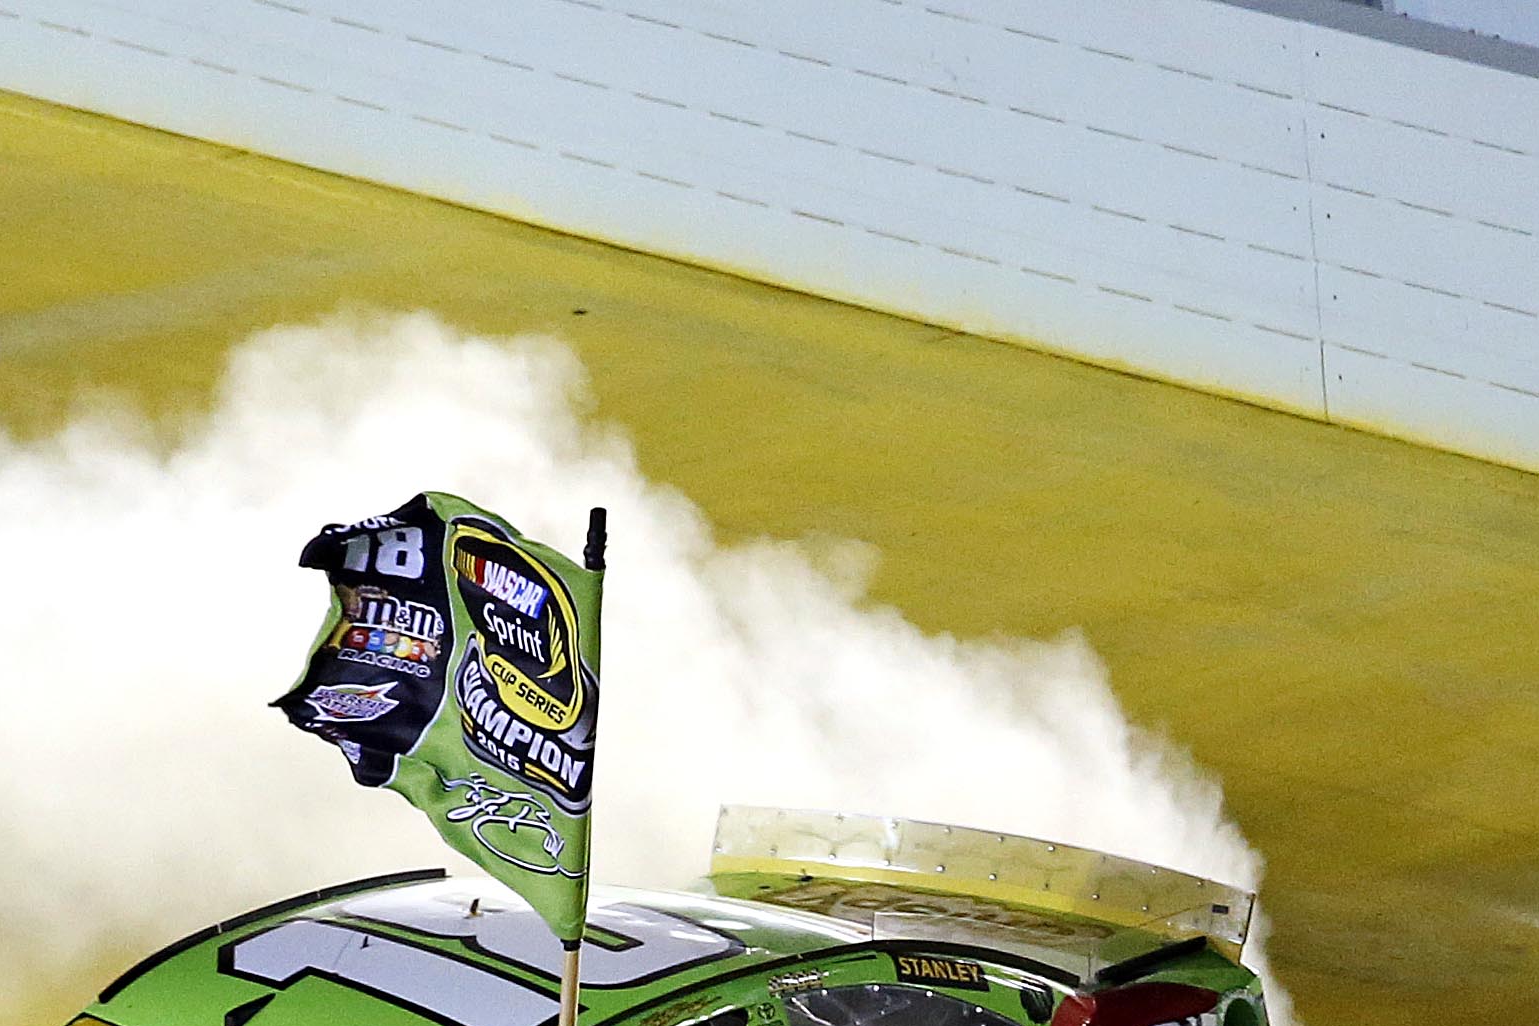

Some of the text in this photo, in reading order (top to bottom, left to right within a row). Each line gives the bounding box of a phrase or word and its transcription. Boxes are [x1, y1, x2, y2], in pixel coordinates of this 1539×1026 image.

[340, 526, 425, 579] 18
[482, 560, 543, 618] NASCAR
[483, 602, 545, 663] Sprint
[338, 648, 431, 678] RACING
[491, 660, 567, 725] CUP SERIES
[477, 730, 520, 771] 2015
[898, 956, 981, 984] STANLEY
